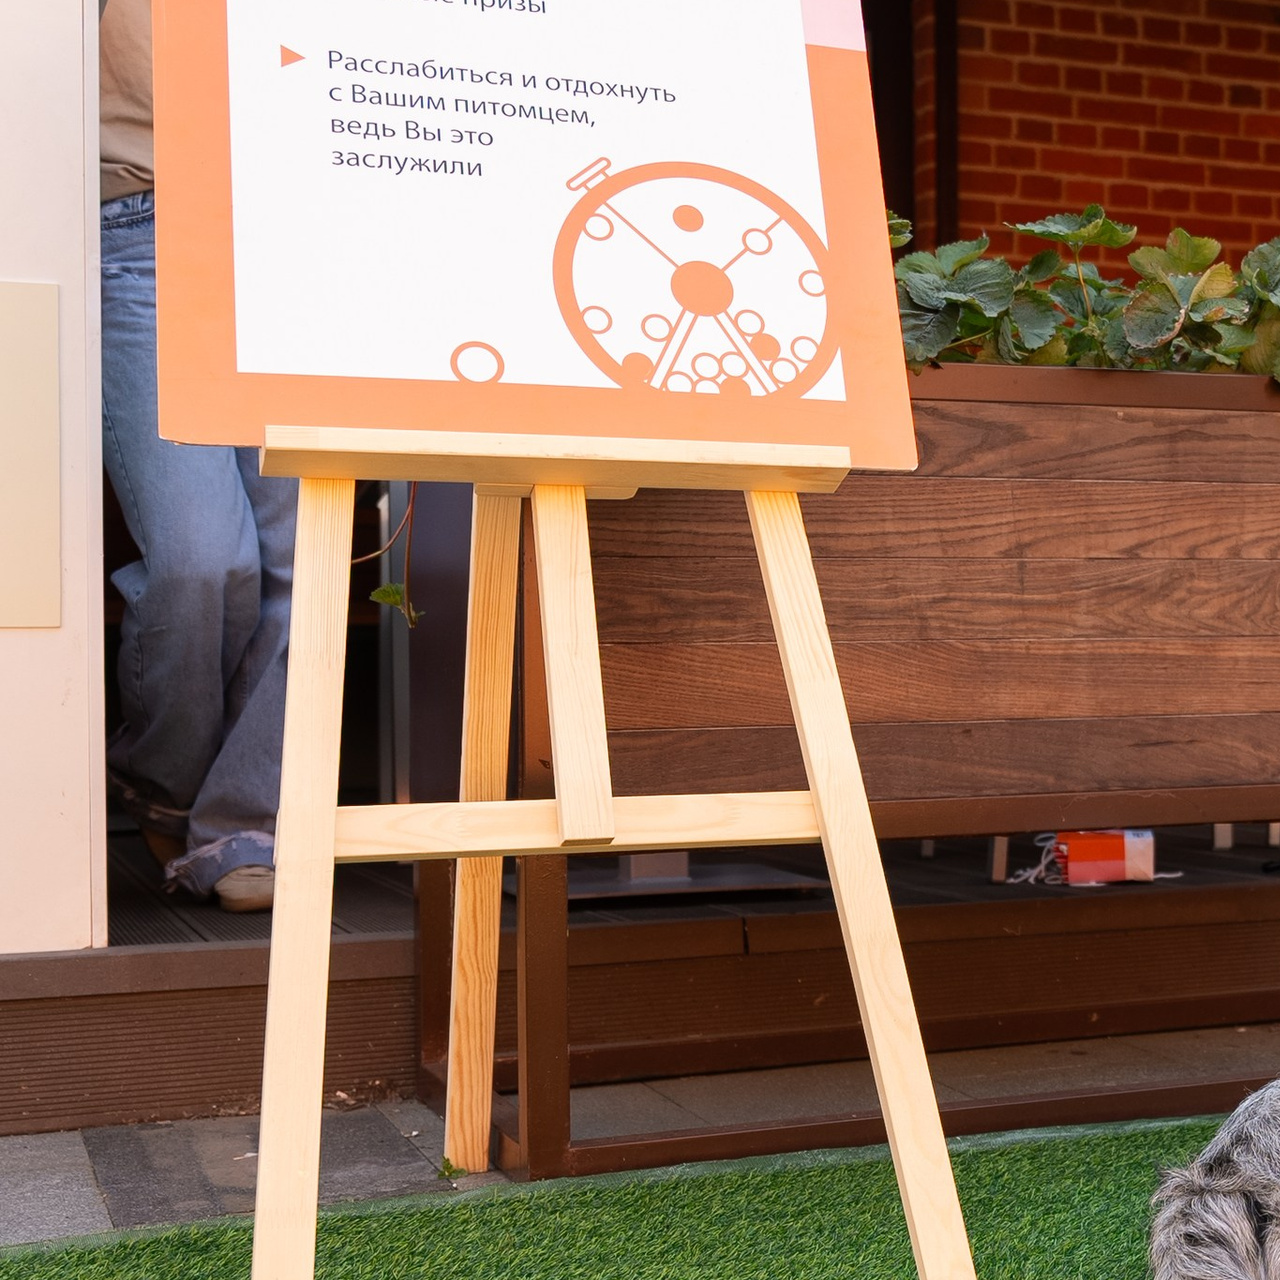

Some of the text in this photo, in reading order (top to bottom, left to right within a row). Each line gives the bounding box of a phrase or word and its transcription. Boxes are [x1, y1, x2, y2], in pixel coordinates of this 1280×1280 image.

[328, 50, 676, 105] Расслабиться и отдохнуть
[328, 83, 596, 128] с Вашим питомцем,
[331, 118, 494, 146] ведь Вы это
[332, 150, 482, 177] заслужили
